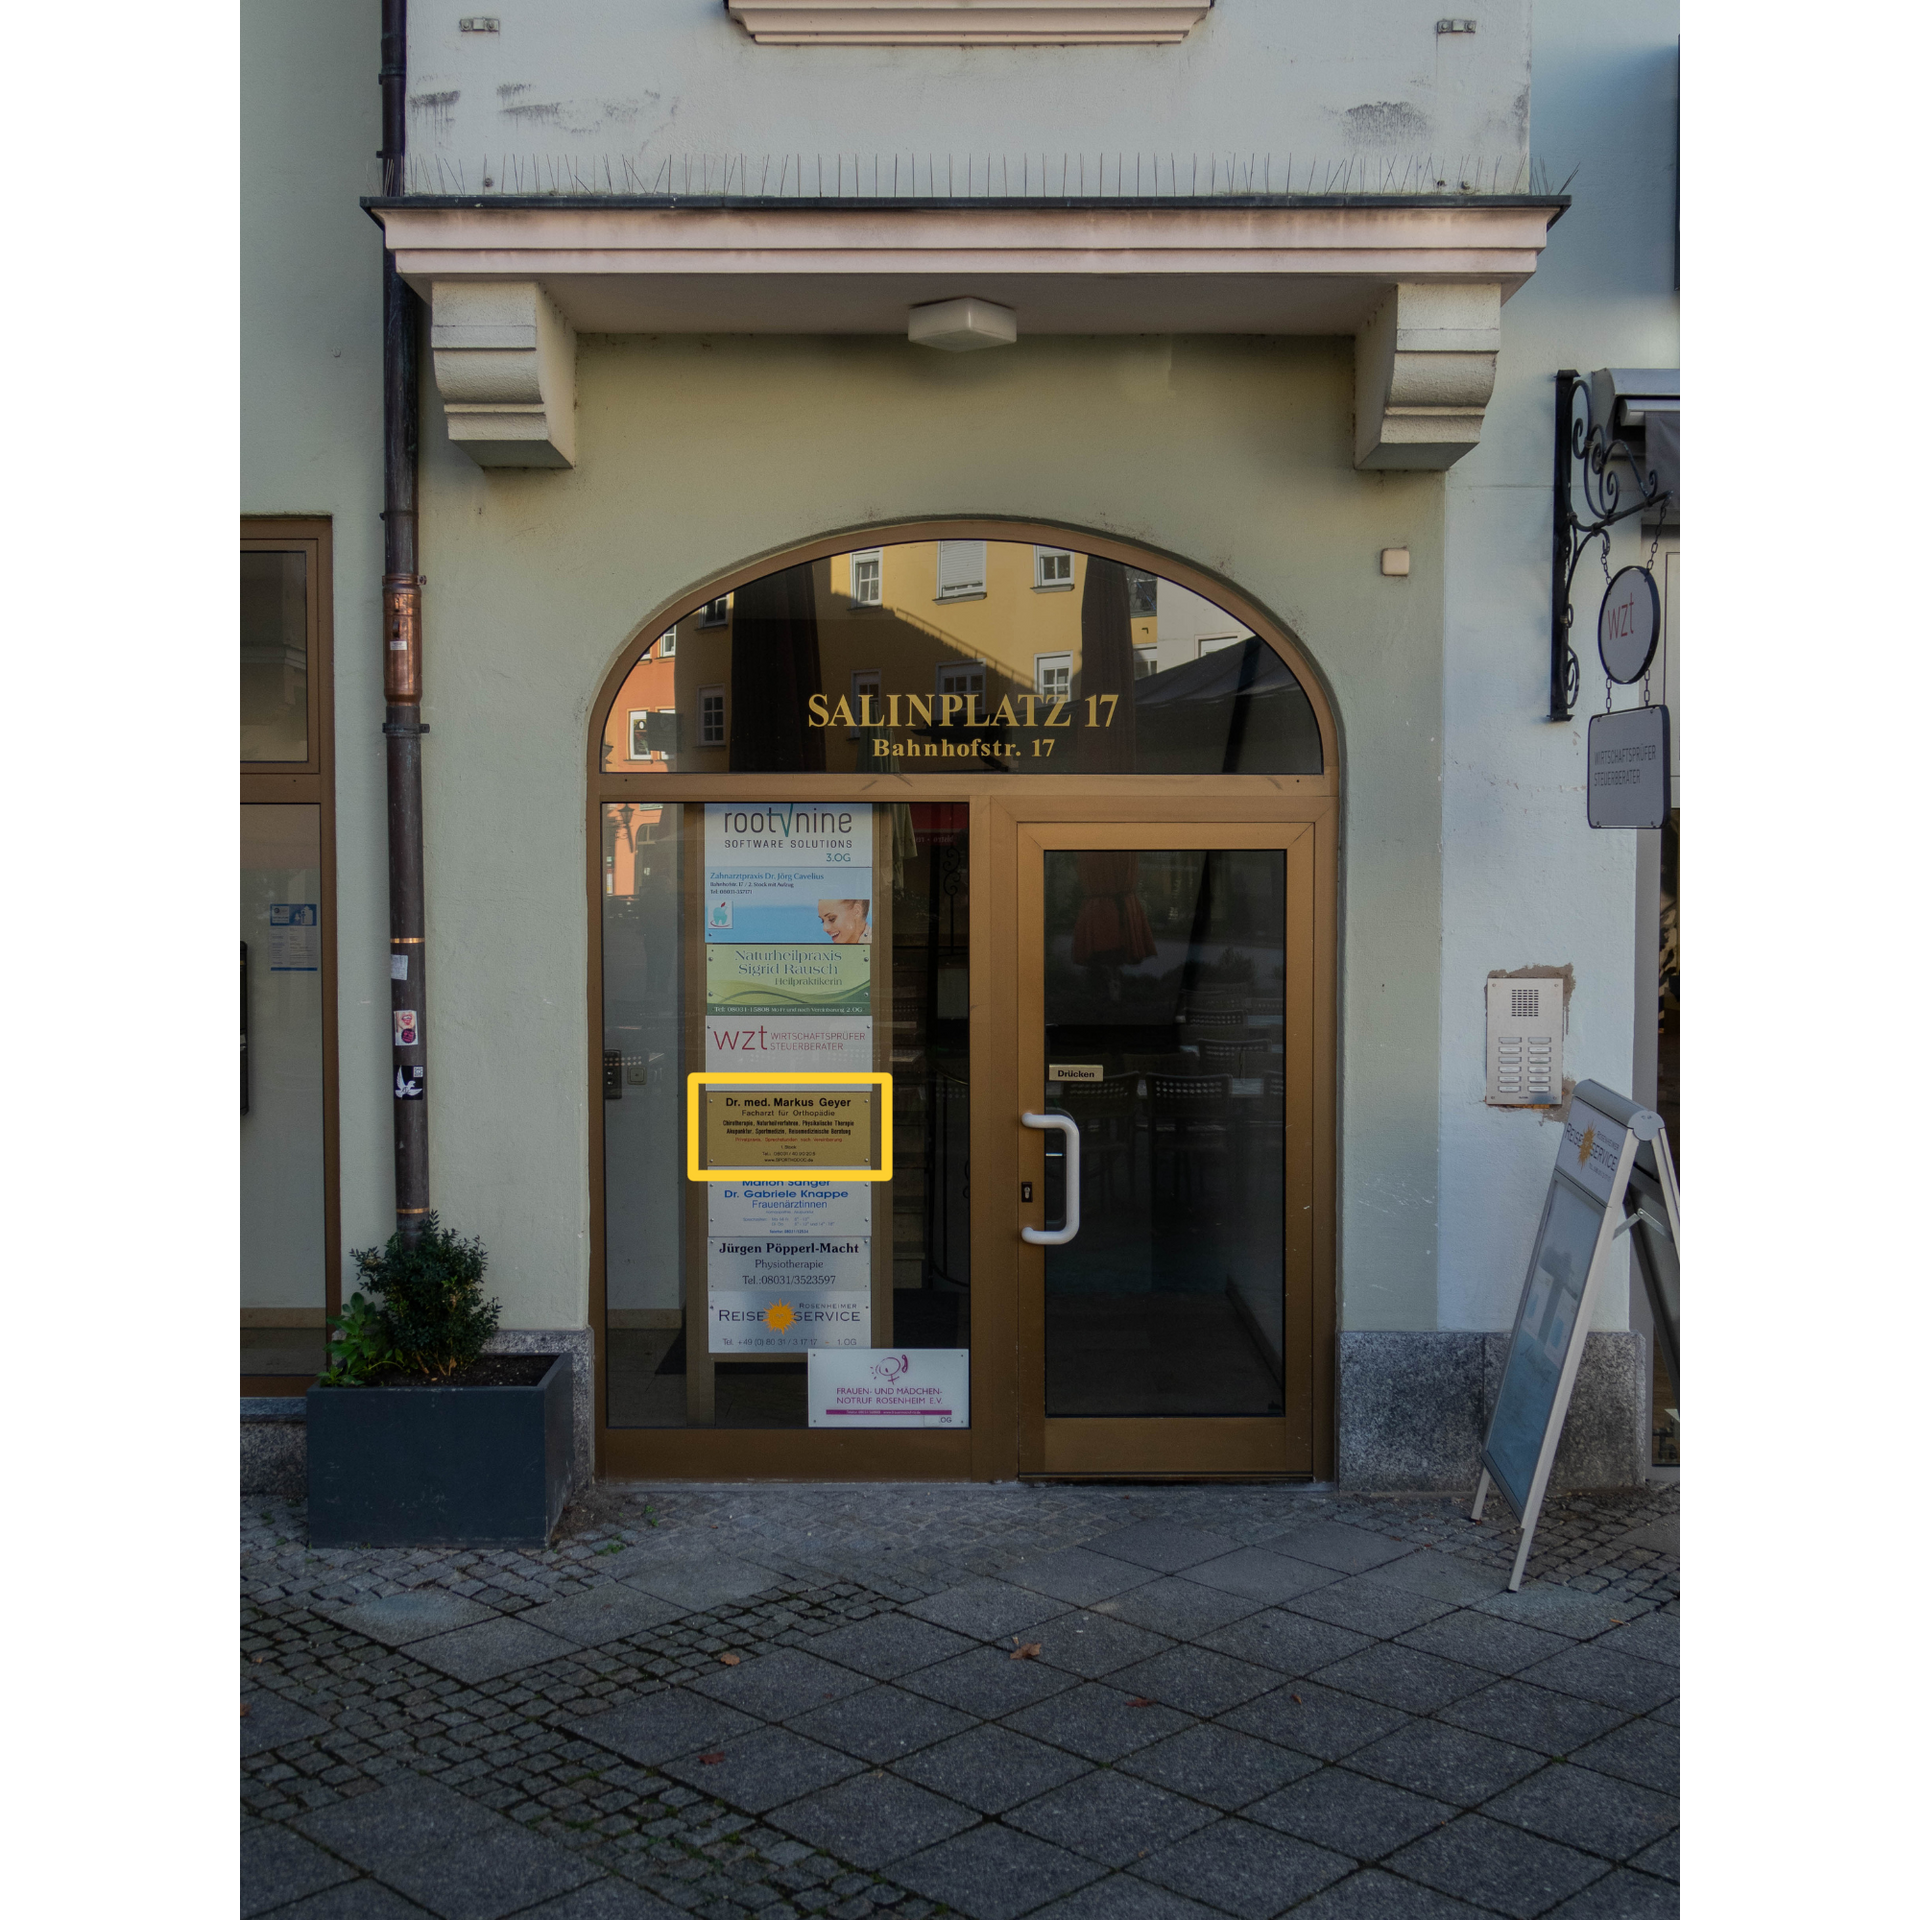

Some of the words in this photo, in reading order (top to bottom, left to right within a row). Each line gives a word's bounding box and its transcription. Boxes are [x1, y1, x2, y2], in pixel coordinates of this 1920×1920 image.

[1607, 592, 1635, 641] wzt
[808, 693, 1072, 728] SALINPLATZ
[1085, 694, 1119, 728] 17
[872, 738, 1022, 757] Bahnhofstr.
[1031, 738, 1055, 757] 17
[1594, 743, 1656, 766] WIRTSCHAFTSPRÜFER
[1594, 768, 1640, 786] STEUERBERATER
[724, 839, 784, 849] SOFTWARE
[790, 839, 853, 849] SOLUTIONS
[826, 852, 851, 863] 3.OG
[710, 872, 764, 881] Zahnarztpraxis
[764, 872, 776, 880] Dr.
[777, 872, 793, 882] Jörg
[794, 872, 824, 880] Cavelius
[735, 949, 842, 963] Naturheilpraxis
[738, 963, 779, 976] Sigrid
[784, 963, 838, 975] Rausch
[775, 977, 842, 986] Heilpraktikerin
[714, 1025, 768, 1051] wzt
[770, 1031, 866, 1041] WIRTSCHAFTSPRÜFER
[770, 1042, 844, 1051] STEUERBERATER
[1058, 1069, 1095, 1078] Drücken
[726, 1097, 740, 1107] Dr.
[744, 1097, 771, 1107] med.
[774, 1097, 814, 1107] Markus
[819, 1097, 851, 1109] Geyer
[831, 1128, 851, 1136] Beratung
[1564, 1122, 1584, 1148] REISE
[1590, 1142, 1618, 1171] SERVICE
[724, 1190, 740, 1198] Dr.
[744, 1190, 797, 1198] Gabriele
[800, 1190, 849, 1200] Knappe
[752, 1199, 828, 1209] Frauenärztinnen
[719, 1242, 762, 1256] Jürgen
[766, 1242, 859, 1256] Pöpperl-Macht
[754, 1259, 824, 1270] Physiotherapie
[742, 1275, 836, 1286] Tel.:08031/3523597
[719, 1309, 766, 1322] REISE
[793, 1311, 860, 1322] SERVICE
[754, 1338, 764, 1346] (0)
[765, 1338, 776, 1346] 80
[896, 1386, 942, 1395] MÄDCHEN-
